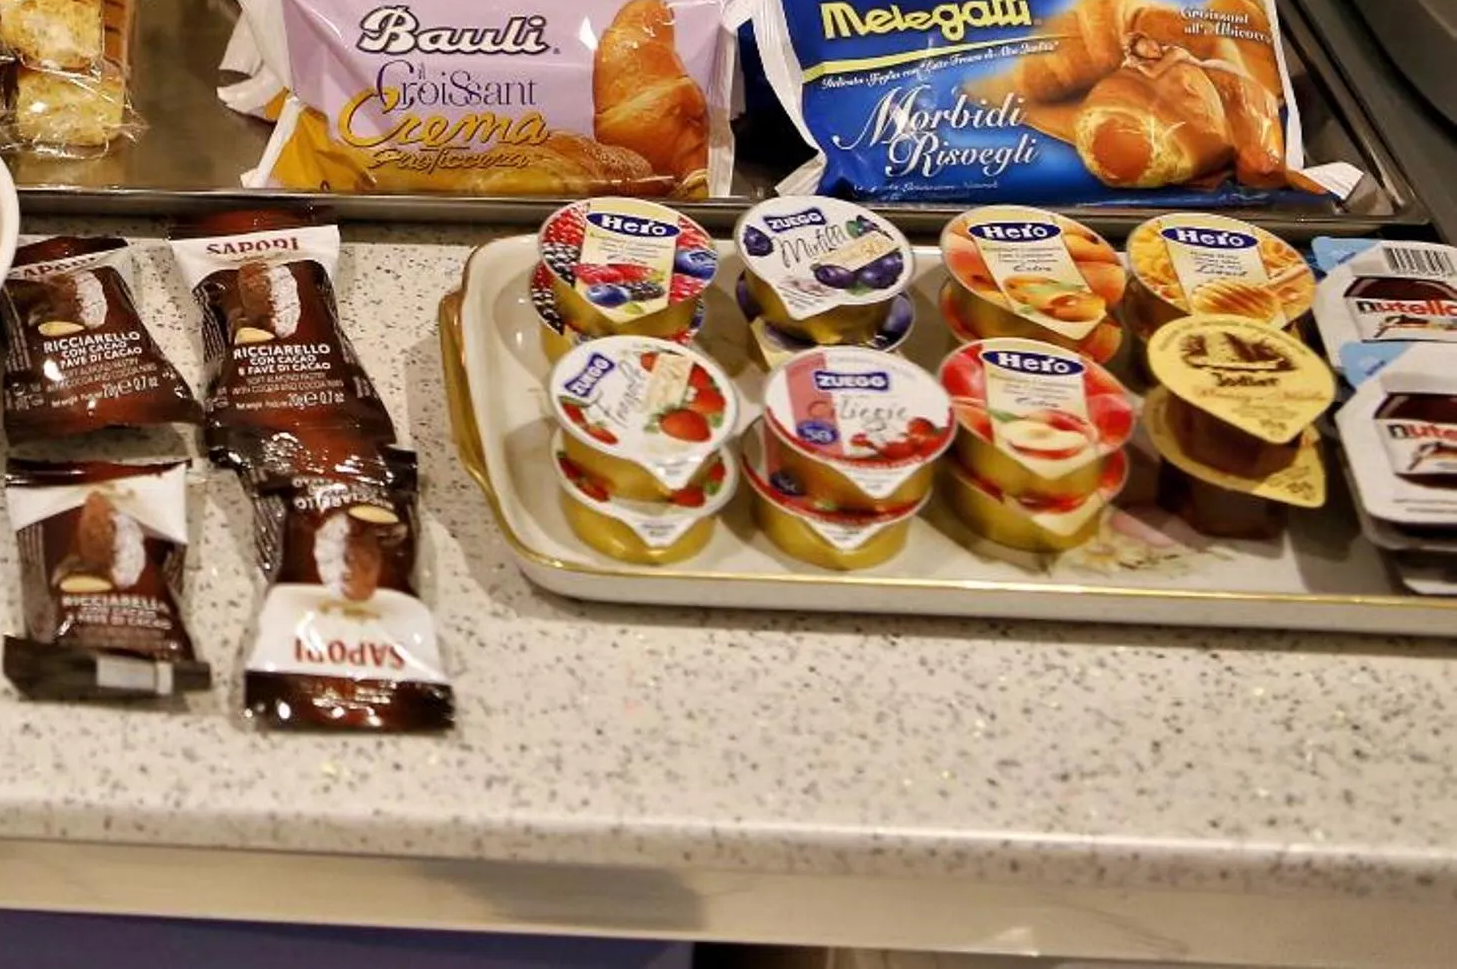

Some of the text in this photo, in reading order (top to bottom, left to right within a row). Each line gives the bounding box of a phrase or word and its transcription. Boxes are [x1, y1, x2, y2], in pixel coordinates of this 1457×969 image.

[356, 5, 551, 56] Bauli
[338, 85, 551, 148] Crema
[831, 84, 1029, 150] Morbidi
[881, 132, 1040, 178] Risvegli
[601, 214, 668, 236] Hero
[981, 223, 1049, 240] Hero
[1175, 228, 1245, 248] Hero
[42, 330, 141, 354] RICCIARELLO
[103, 346, 142, 360] CACAO
[232, 343, 331, 360] RICCIARELLO
[249, 353, 317, 367] CON CACAO
[292, 362, 332, 372] CACAO
[997, 352, 1071, 374] Hero
